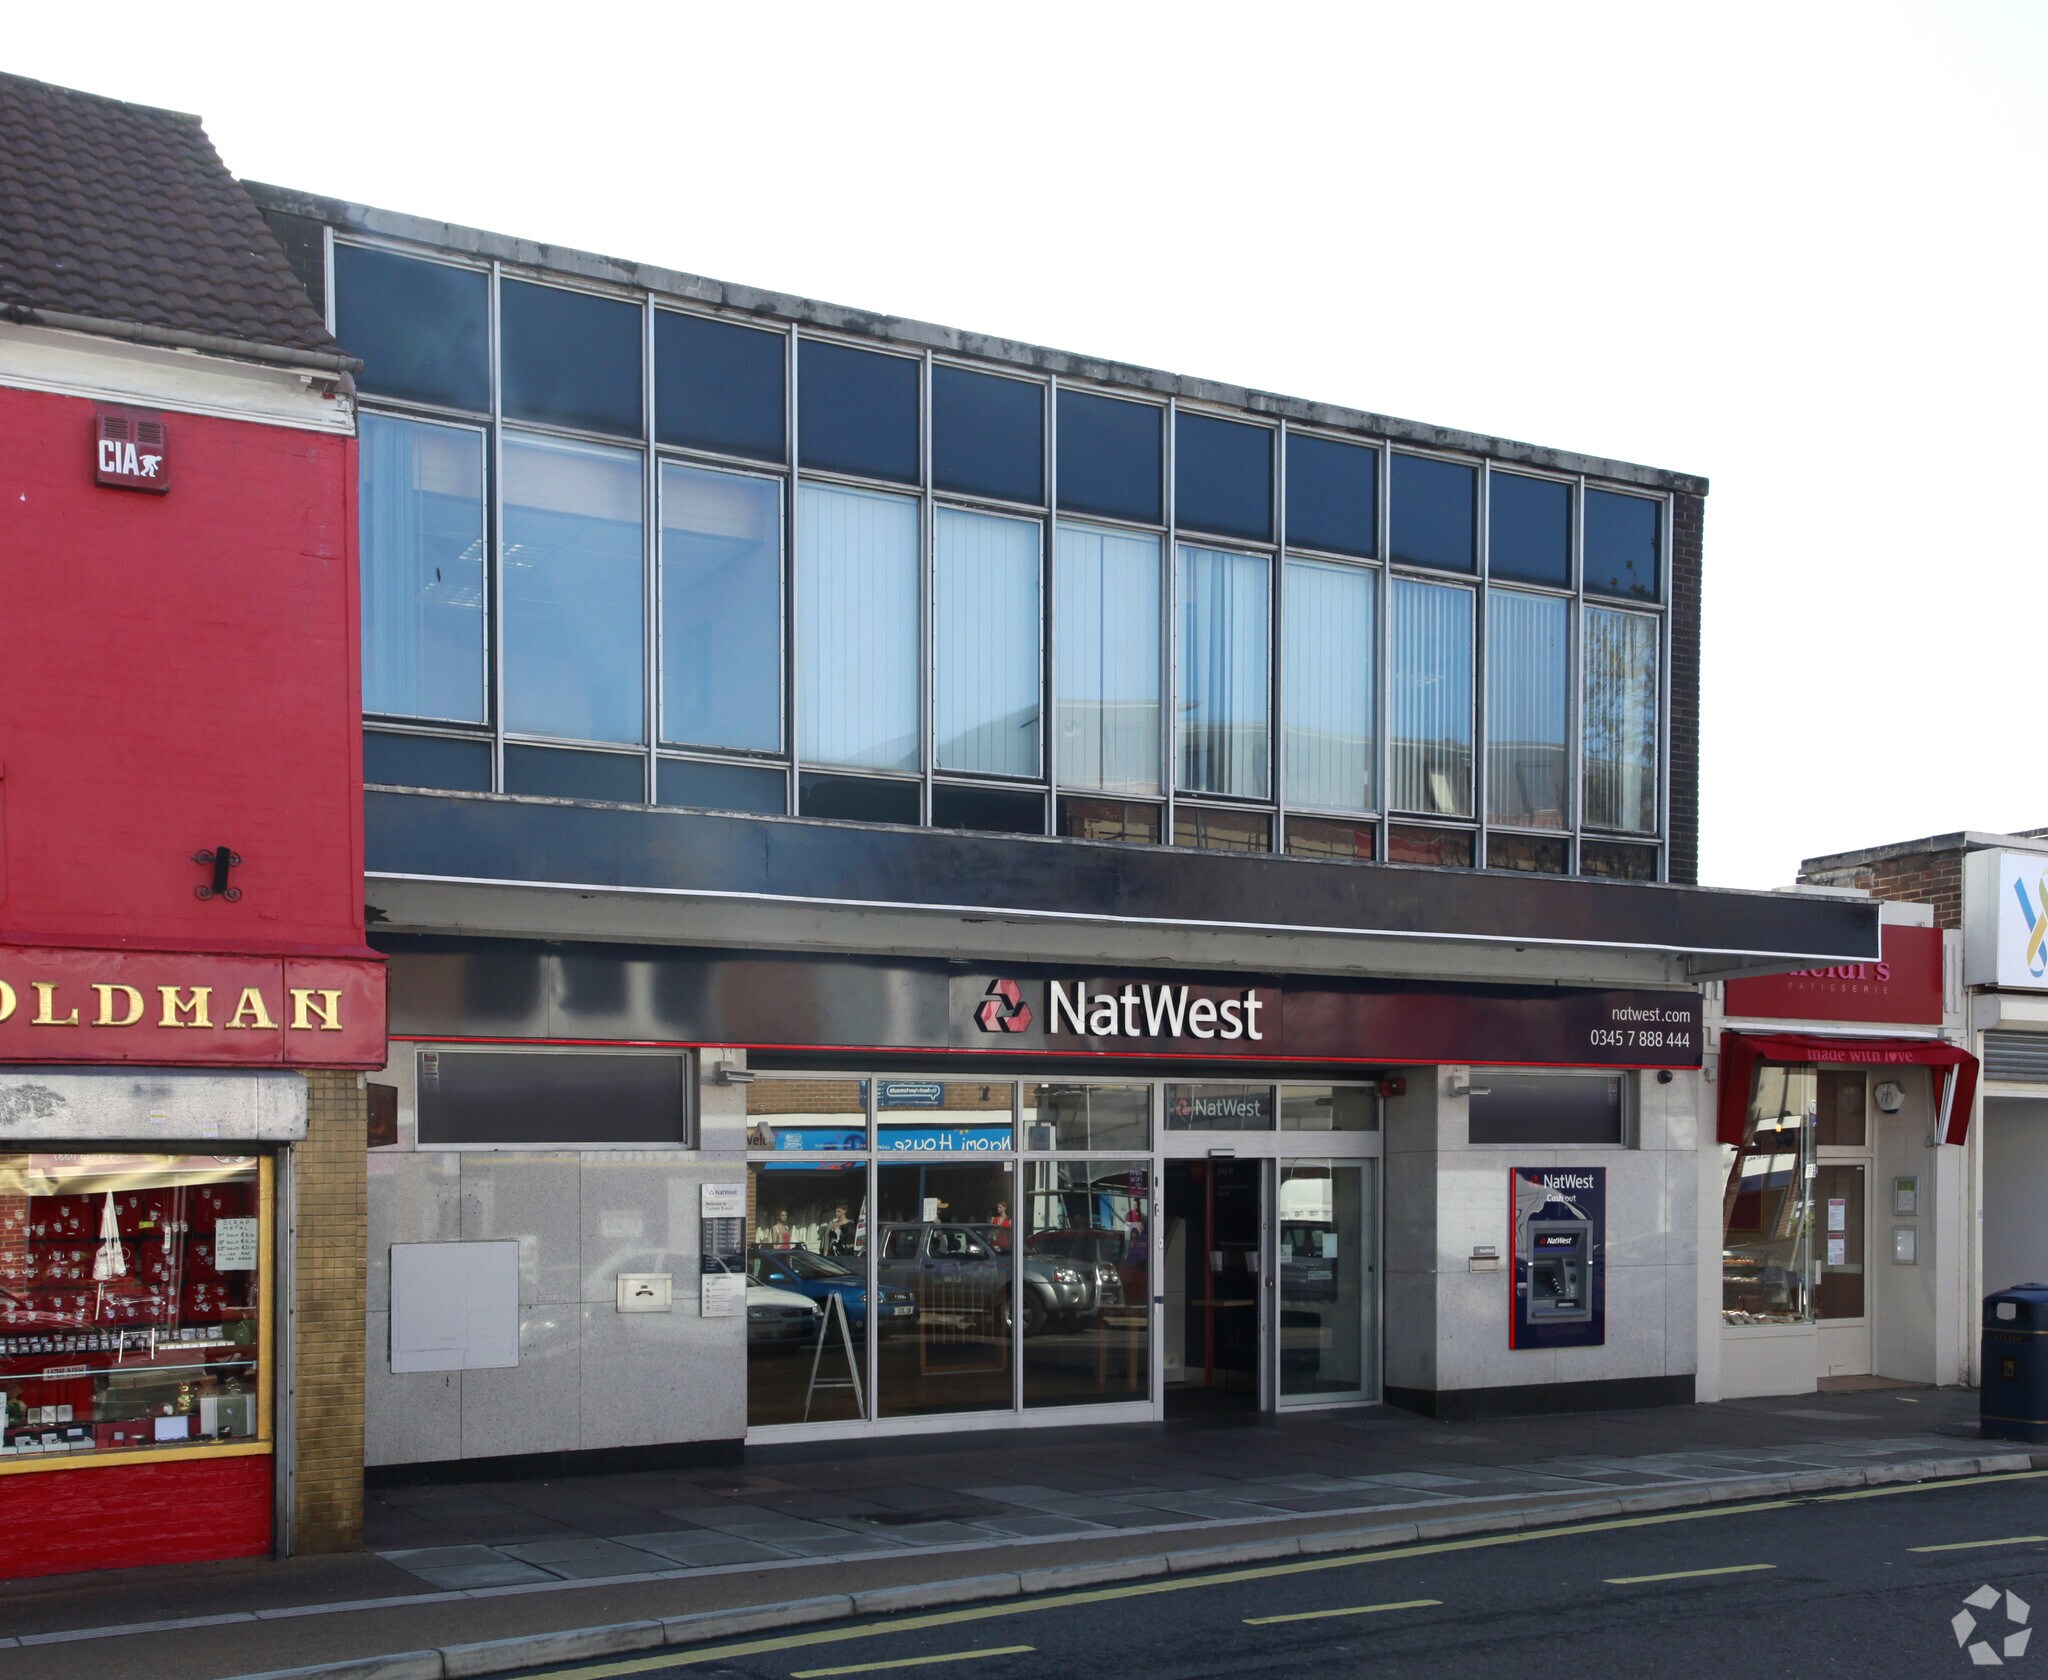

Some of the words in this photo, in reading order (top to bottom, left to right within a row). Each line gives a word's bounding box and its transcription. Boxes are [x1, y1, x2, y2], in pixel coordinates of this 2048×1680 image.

[98, 439, 139, 476] CIA
[1787, 982, 1889, 995] PATISSERIE
[1046, 979, 1263, 1041] NatWest
[1611, 1006, 1691, 1023] natwest.com
[1590, 1029, 1623, 1046] 0345
[1627, 1030, 1636, 1047] 7
[1638, 1031, 1663, 1047] 888
[1666, 1032, 1690, 1048] 444
[1195, 1098, 1261, 1117] NatWest
[1543, 1173, 1594, 1189] NatWest
[1546, 1193, 1564, 1203] Cash
[1564, 1194, 1577, 1203] out
[1546, 1236, 1572, 1245] NatWest
